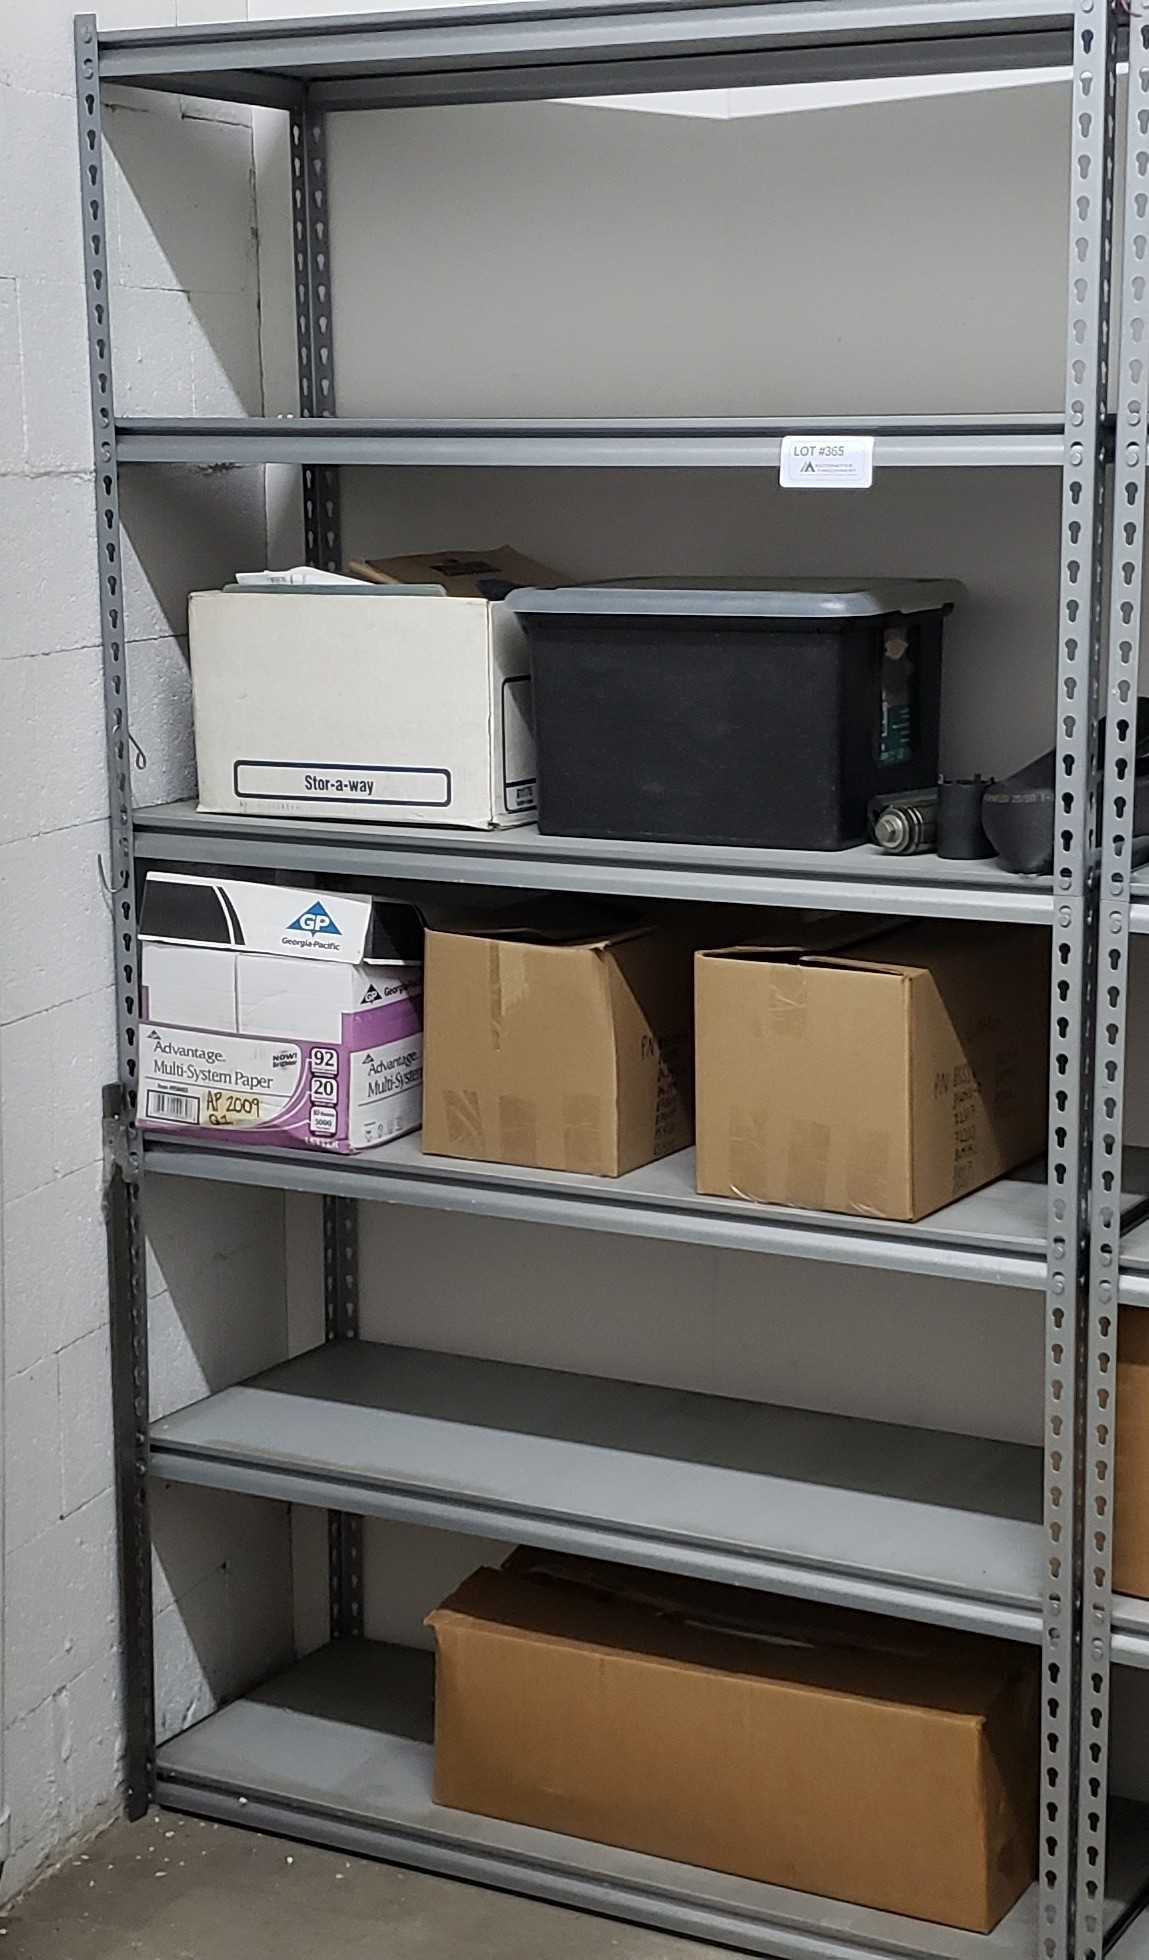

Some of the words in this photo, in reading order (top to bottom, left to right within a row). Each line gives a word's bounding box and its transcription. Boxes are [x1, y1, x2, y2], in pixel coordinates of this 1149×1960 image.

[793, 446, 816, 456] LOT
[818, 446, 845, 457] #365
[304, 774, 374, 796] Stor-a-way
[299, 913, 330, 931] GP
[281, 937, 341, 951] Georgia-Pacific
[153, 1041, 223, 1064] Advantage
[314, 1050, 335, 1067] 92
[368, 1051, 417, 1077] Advantage
[153, 1059, 232, 1082] Multi-System
[234, 1071, 273, 1090] Paper
[314, 1080, 334, 1096] 20
[206, 1090, 223, 1112] AP
[226, 1095, 260, 1118] 2009
[208, 1113, 234, 1126] Q1
